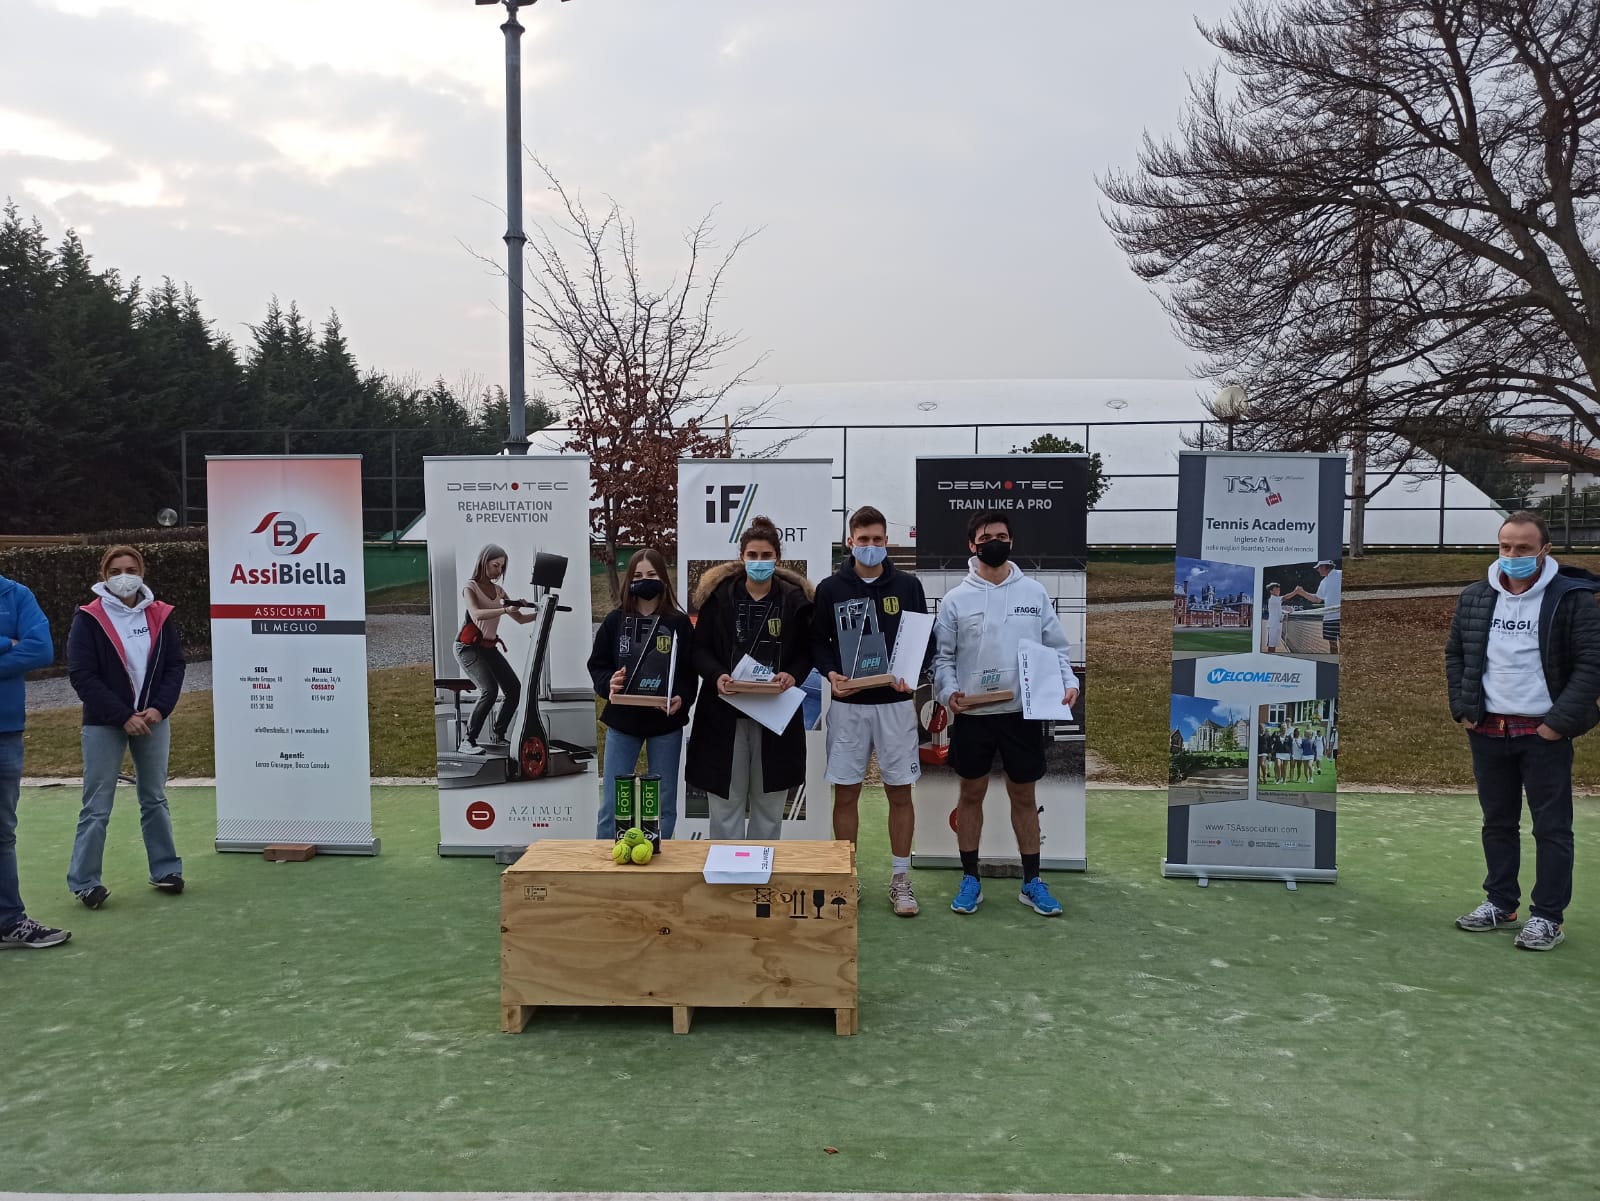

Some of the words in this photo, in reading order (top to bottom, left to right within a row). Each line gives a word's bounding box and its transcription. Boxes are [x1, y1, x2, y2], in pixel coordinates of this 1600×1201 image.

[1224, 475, 1271, 493] TSA
[458, 501, 552, 511] REHABILITATION
[949, 499, 984, 510] TRAIN
[988, 499, 1013, 510] LIKE
[1016, 499, 1025, 509] A
[1027, 499, 1052, 510] PRO
[466, 513, 473, 523] &
[476, 512, 548, 523] PREVENTION
[1205, 517, 1249, 530] Tennis
[1252, 518, 1316, 534] Academy
[1234, 536, 1258, 544] Inglese
[230, 562, 346, 585] AssiBiella
[254, 606, 321, 617] ASSICURATI
[260, 622, 269, 632] IL
[273, 622, 318, 633] MEGLIO
[861, 656, 882, 669] OPEN
[254, 666, 269, 674] SEDE
[639, 678, 662, 688] OPEN
[620, 784, 630, 813] FORT
[645, 785, 655, 814] FORT
[509, 806, 573, 815] AZIMUT
